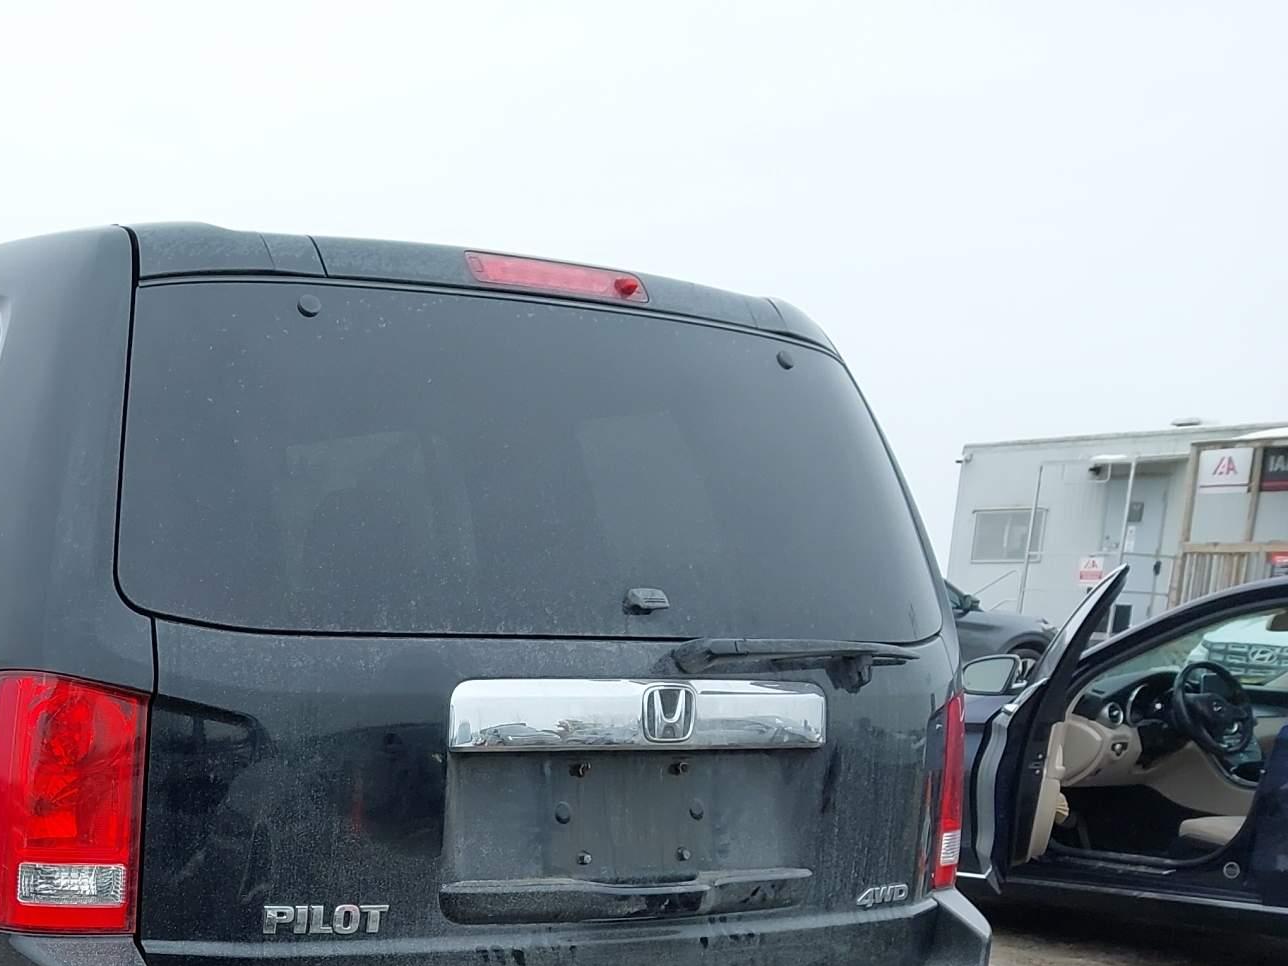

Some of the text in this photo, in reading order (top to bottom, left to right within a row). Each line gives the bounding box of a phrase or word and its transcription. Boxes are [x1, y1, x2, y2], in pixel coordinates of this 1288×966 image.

[1268, 455, 1288, 472] IA
[856, 884, 909, 908] 4WD
[262, 904, 390, 935] PILOT
